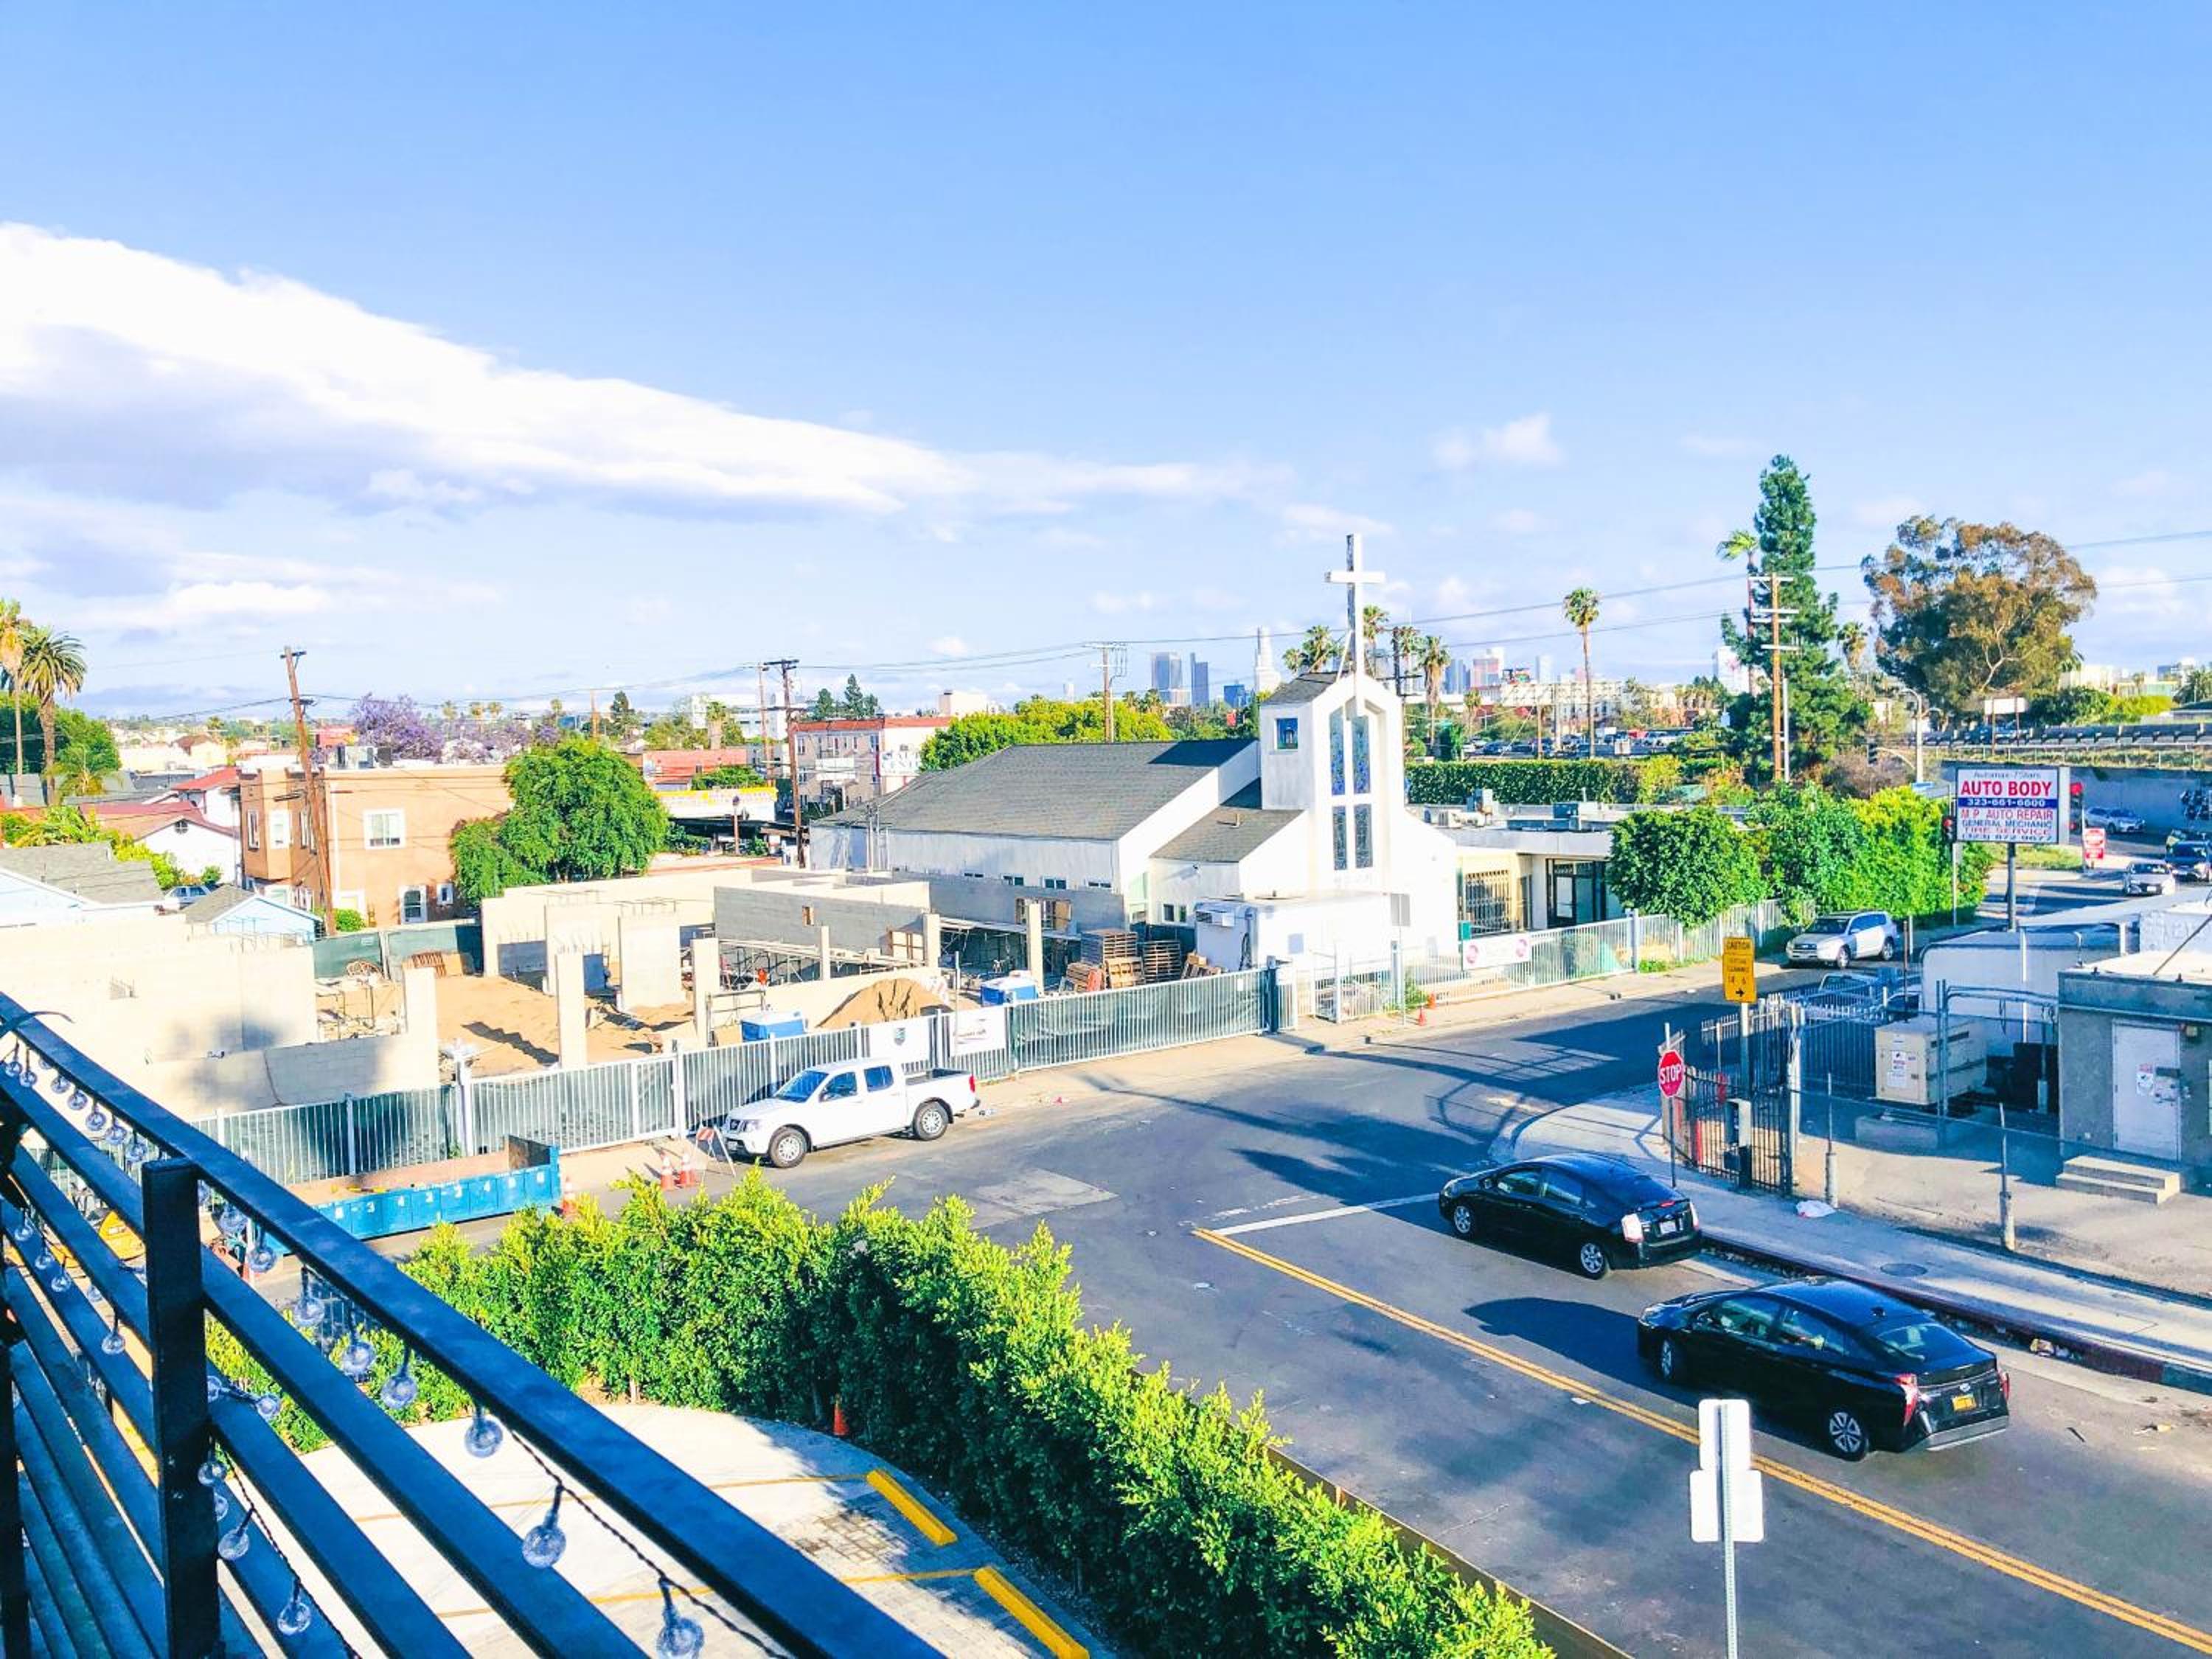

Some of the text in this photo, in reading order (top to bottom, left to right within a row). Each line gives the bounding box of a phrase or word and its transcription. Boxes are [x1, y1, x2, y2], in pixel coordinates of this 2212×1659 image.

[1961, 780, 2052, 796] AUTO BODY
[1986, 810, 2014, 819] AUTO
[2017, 810, 2053, 820] REPAIR
[2006, 821, 2053, 829] MECHANIC
[1660, 1064, 1682, 1085] STOP
